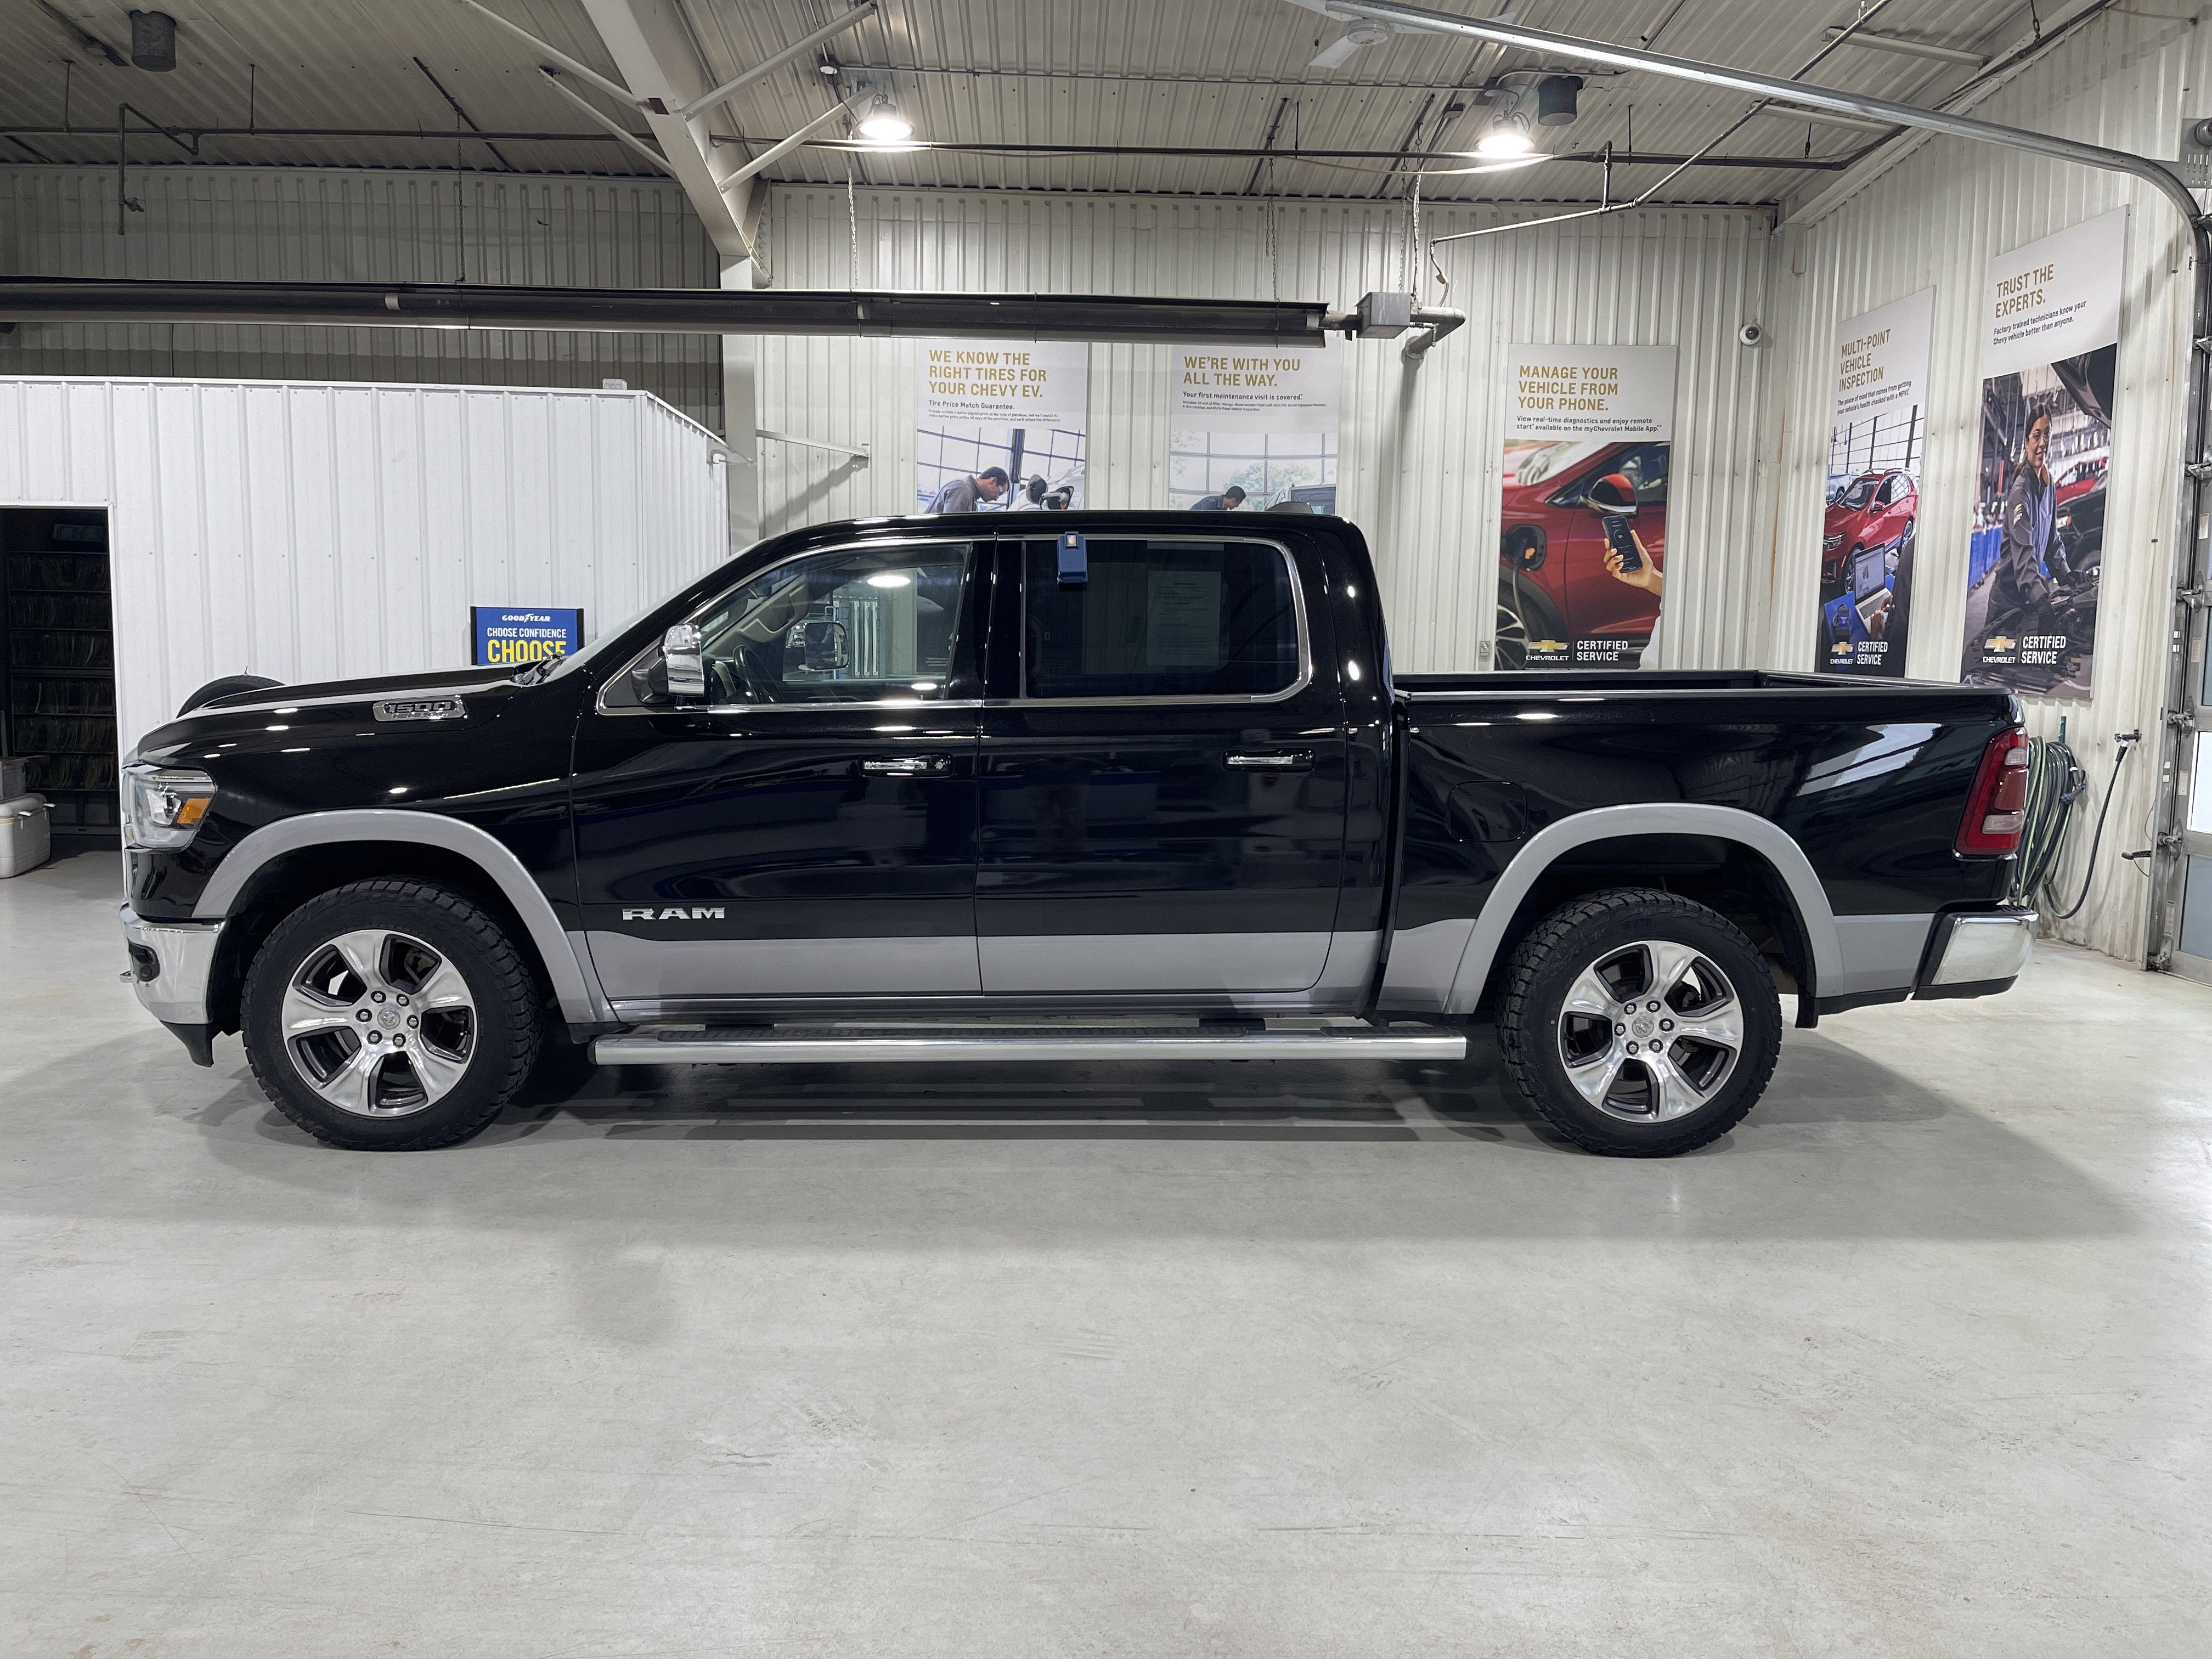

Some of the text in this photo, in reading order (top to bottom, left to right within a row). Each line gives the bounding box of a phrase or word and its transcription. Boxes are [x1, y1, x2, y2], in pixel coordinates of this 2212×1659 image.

[1997, 264, 2053, 298] TRUST THE
[1995, 289, 2046, 318] EXPERTS.
[1994, 301, 2087, 335] Factory trained technicians know your
[1993, 316, 2074, 345] Chevy vehicle better than anyone.
[1841, 329, 1891, 358] MULTI-POINT
[929, 349, 1030, 365] WE KNOW THE
[1184, 356, 1300, 371] WE'RE WITH YOU
[1841, 353, 1871, 375] VEHICLE
[929, 365, 1046, 382] RIGHT TIRES FOR
[1183, 372, 1277, 387] ALL THE WAY.
[1520, 365, 1618, 380] MANAGE YOUR
[1839, 366, 1883, 392] INSPECTION
[929, 381, 1043, 398] YOUR CHEVY EV.
[1519, 381, 1618, 395] VEHICLE FROM
[1844, 397, 1854, 406] peace
[1876, 387, 1887, 396] comes
[1888, 385, 1897, 393] from
[1898, 380, 1912, 391] getting
[1518, 396, 1609, 411] YOUR PHONE.
[1871, 396, 1886, 406] checked
[501, 613, 551, 623] GOODYEAR
[487, 627, 567, 639] CHOOSE CONFIDENCE
[1577, 640, 1628, 650] CERTIFIED
[1858, 641, 1888, 652] CERTIFIED
[2023, 635, 2066, 649] CERTIFIED
[1577, 651, 1619, 661] SERVICE
[1857, 654, 1882, 665] SERVICE
[2021, 651, 2057, 664] SERVICE
[384, 701, 451, 713] 1500
[622, 907, 725, 920] RAM
